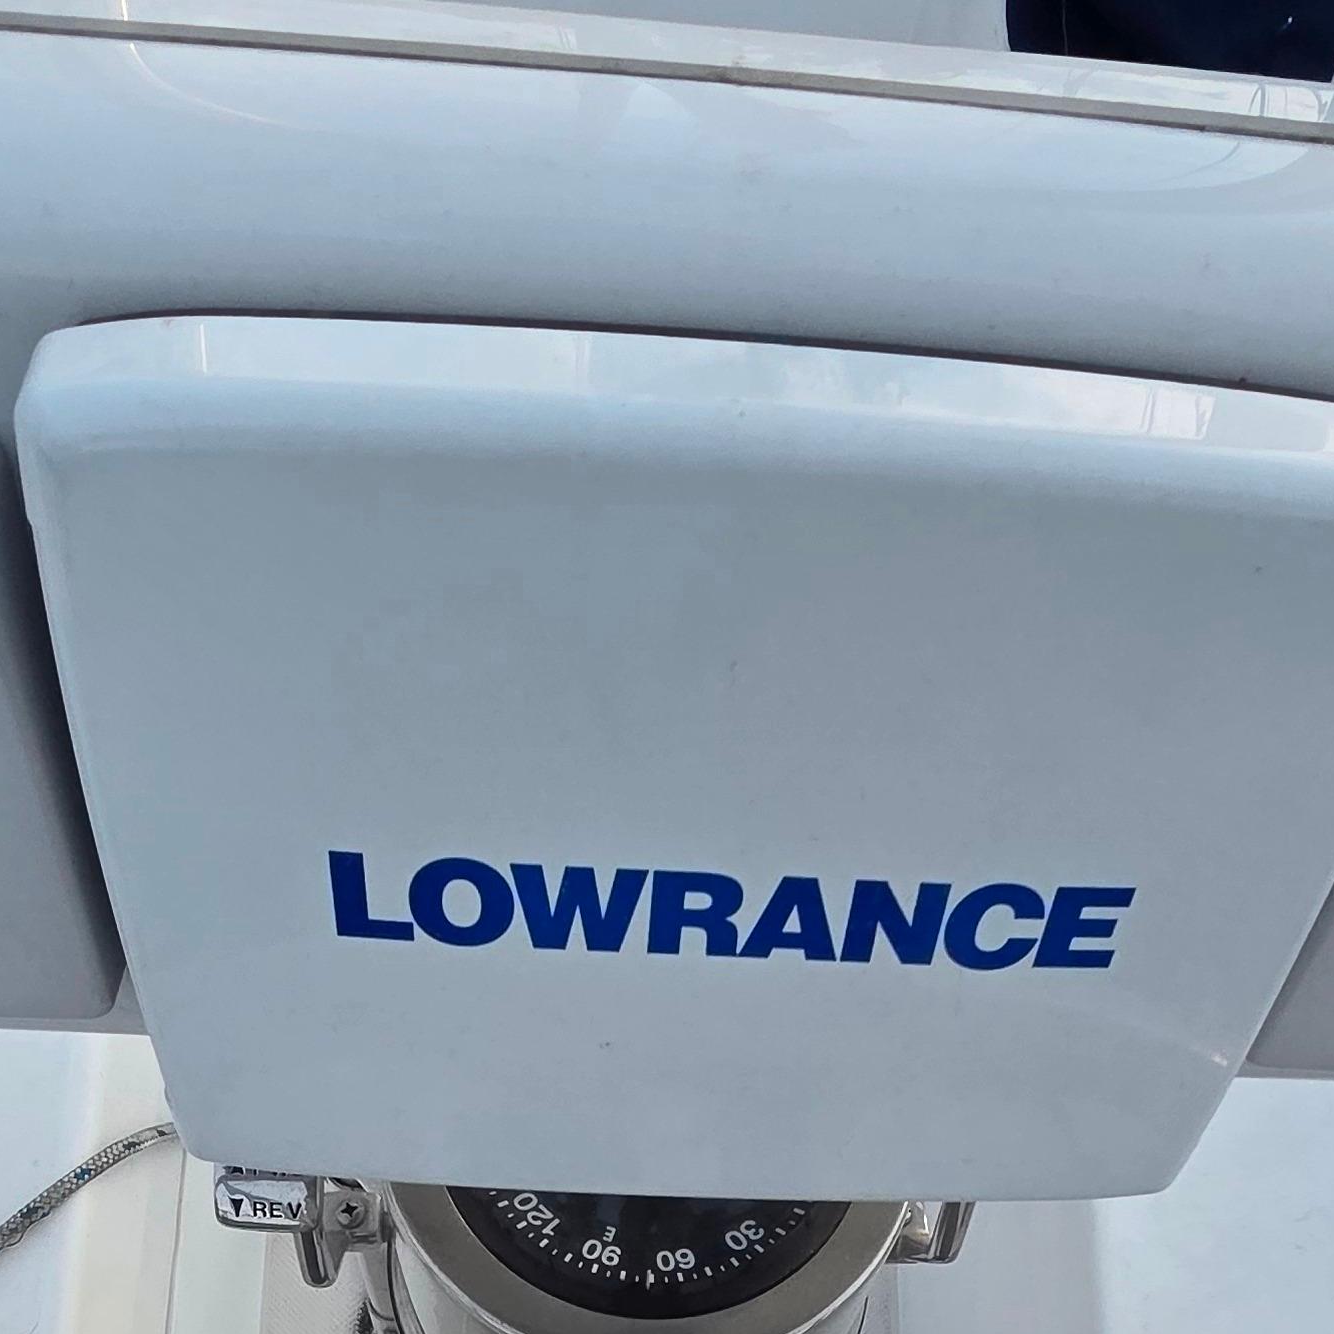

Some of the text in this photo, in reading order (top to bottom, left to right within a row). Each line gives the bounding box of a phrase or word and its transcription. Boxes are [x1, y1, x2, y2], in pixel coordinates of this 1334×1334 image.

[332, 853, 1132, 968] LOWRANCE
[252, 1201, 303, 1219] REV
[513, 1192, 560, 1236] 120
[602, 1226, 617, 1242] E
[724, 1219, 765, 1251] 30
[582, 1239, 622, 1266] 90
[656, 1248, 696, 1272] 60
